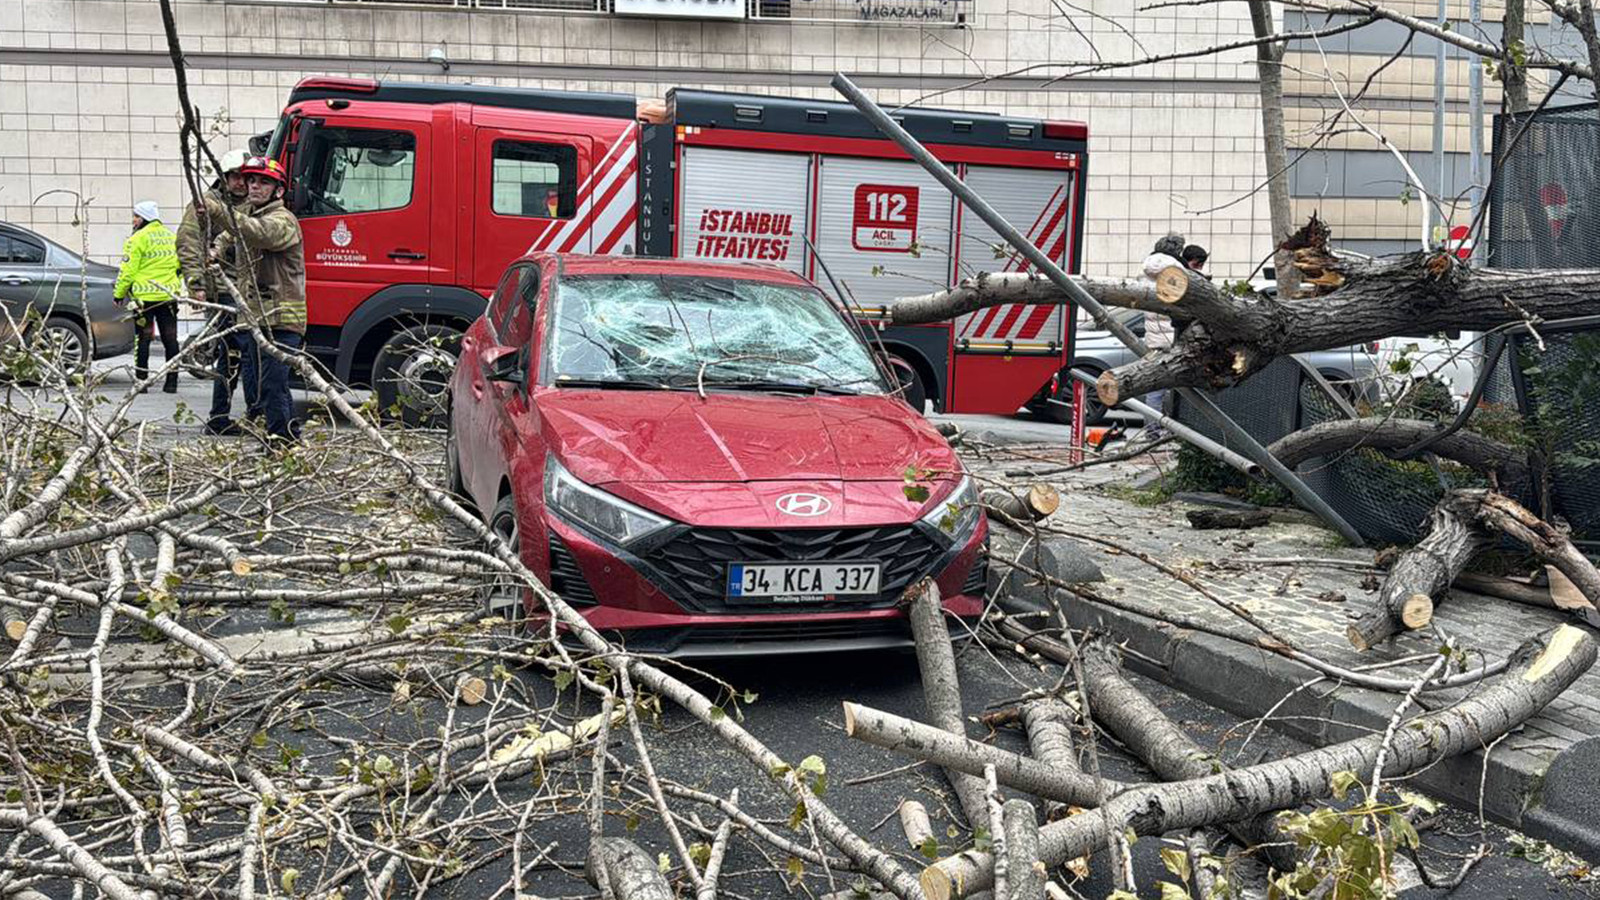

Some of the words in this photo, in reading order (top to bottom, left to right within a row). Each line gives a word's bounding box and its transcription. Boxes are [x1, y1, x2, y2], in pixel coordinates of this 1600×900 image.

[866, 192, 907, 222] 112
[731, 582, 741, 591] TR
[744, 568, 770, 592] 34
[783, 568, 822, 592] KCA
[835, 567, 875, 592] 337
